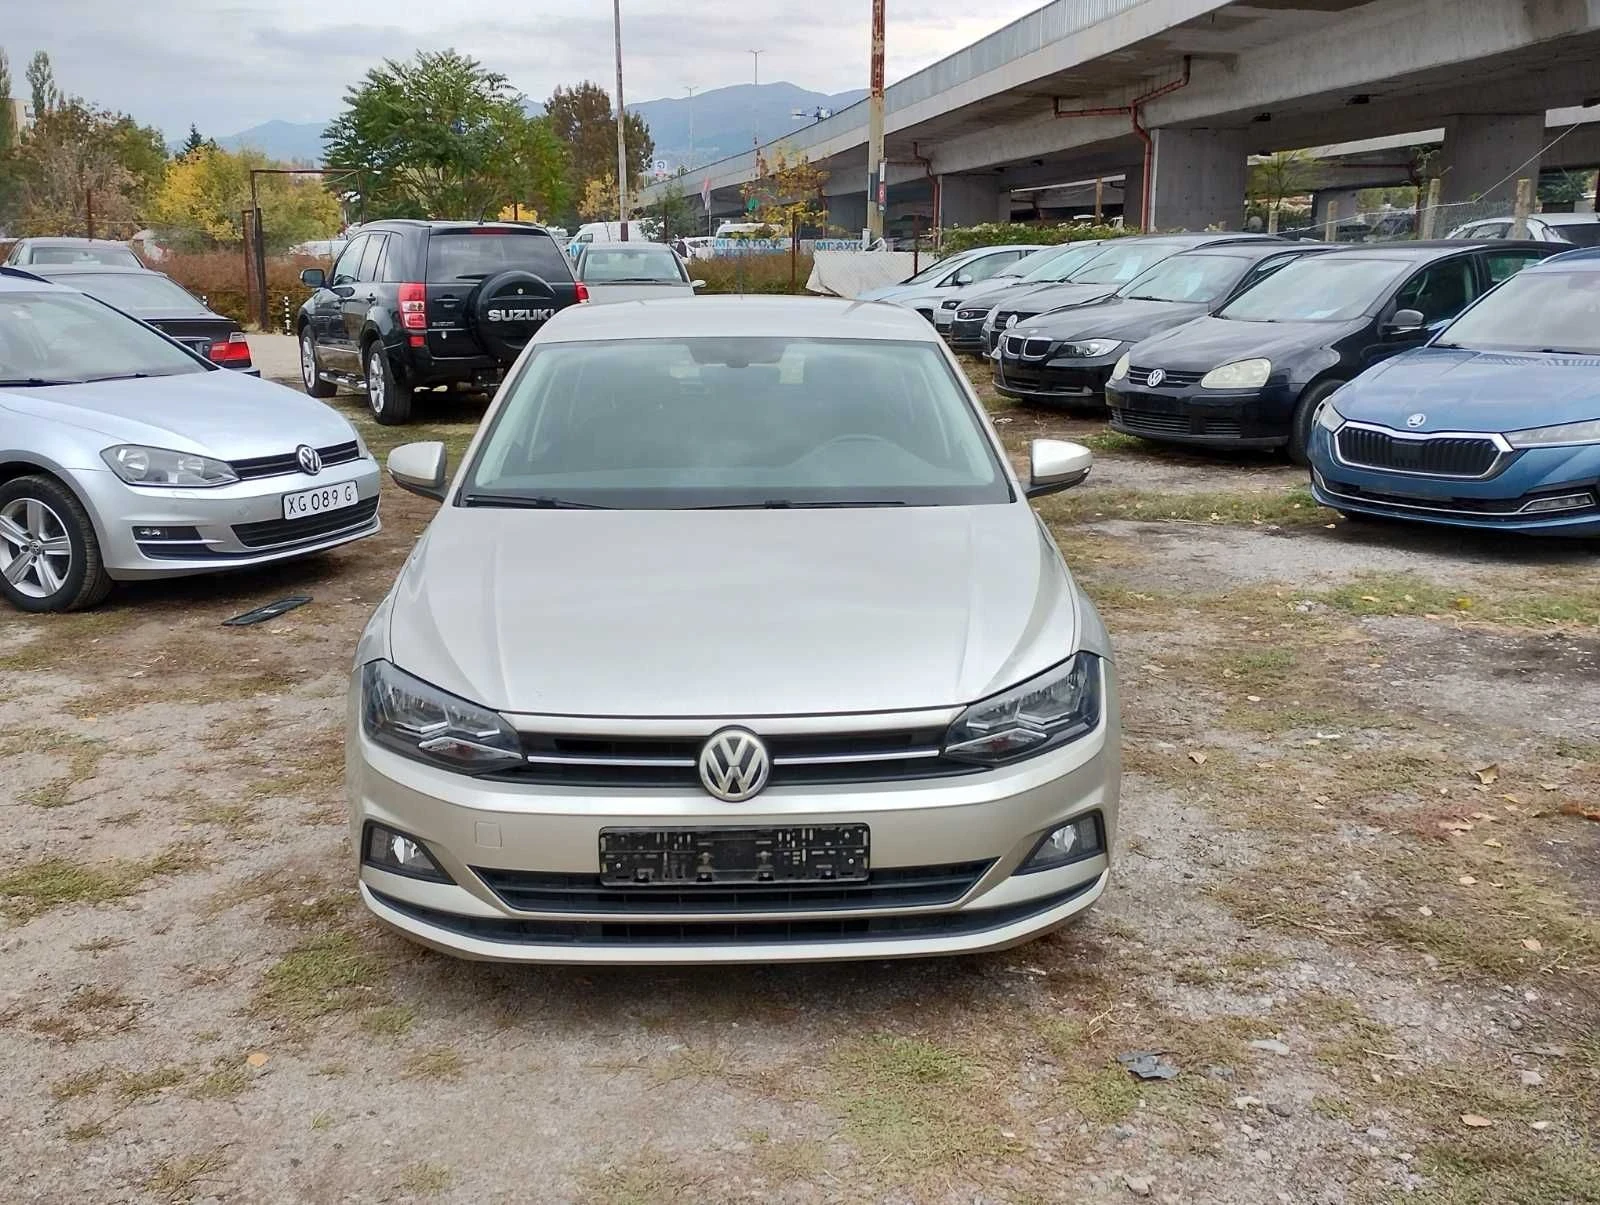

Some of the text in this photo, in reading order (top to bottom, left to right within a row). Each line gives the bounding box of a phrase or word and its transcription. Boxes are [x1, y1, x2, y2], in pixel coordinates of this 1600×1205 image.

[288, 495, 307, 514] XG
[344, 486, 352, 502] G
[701, 728, 770, 800] VW
